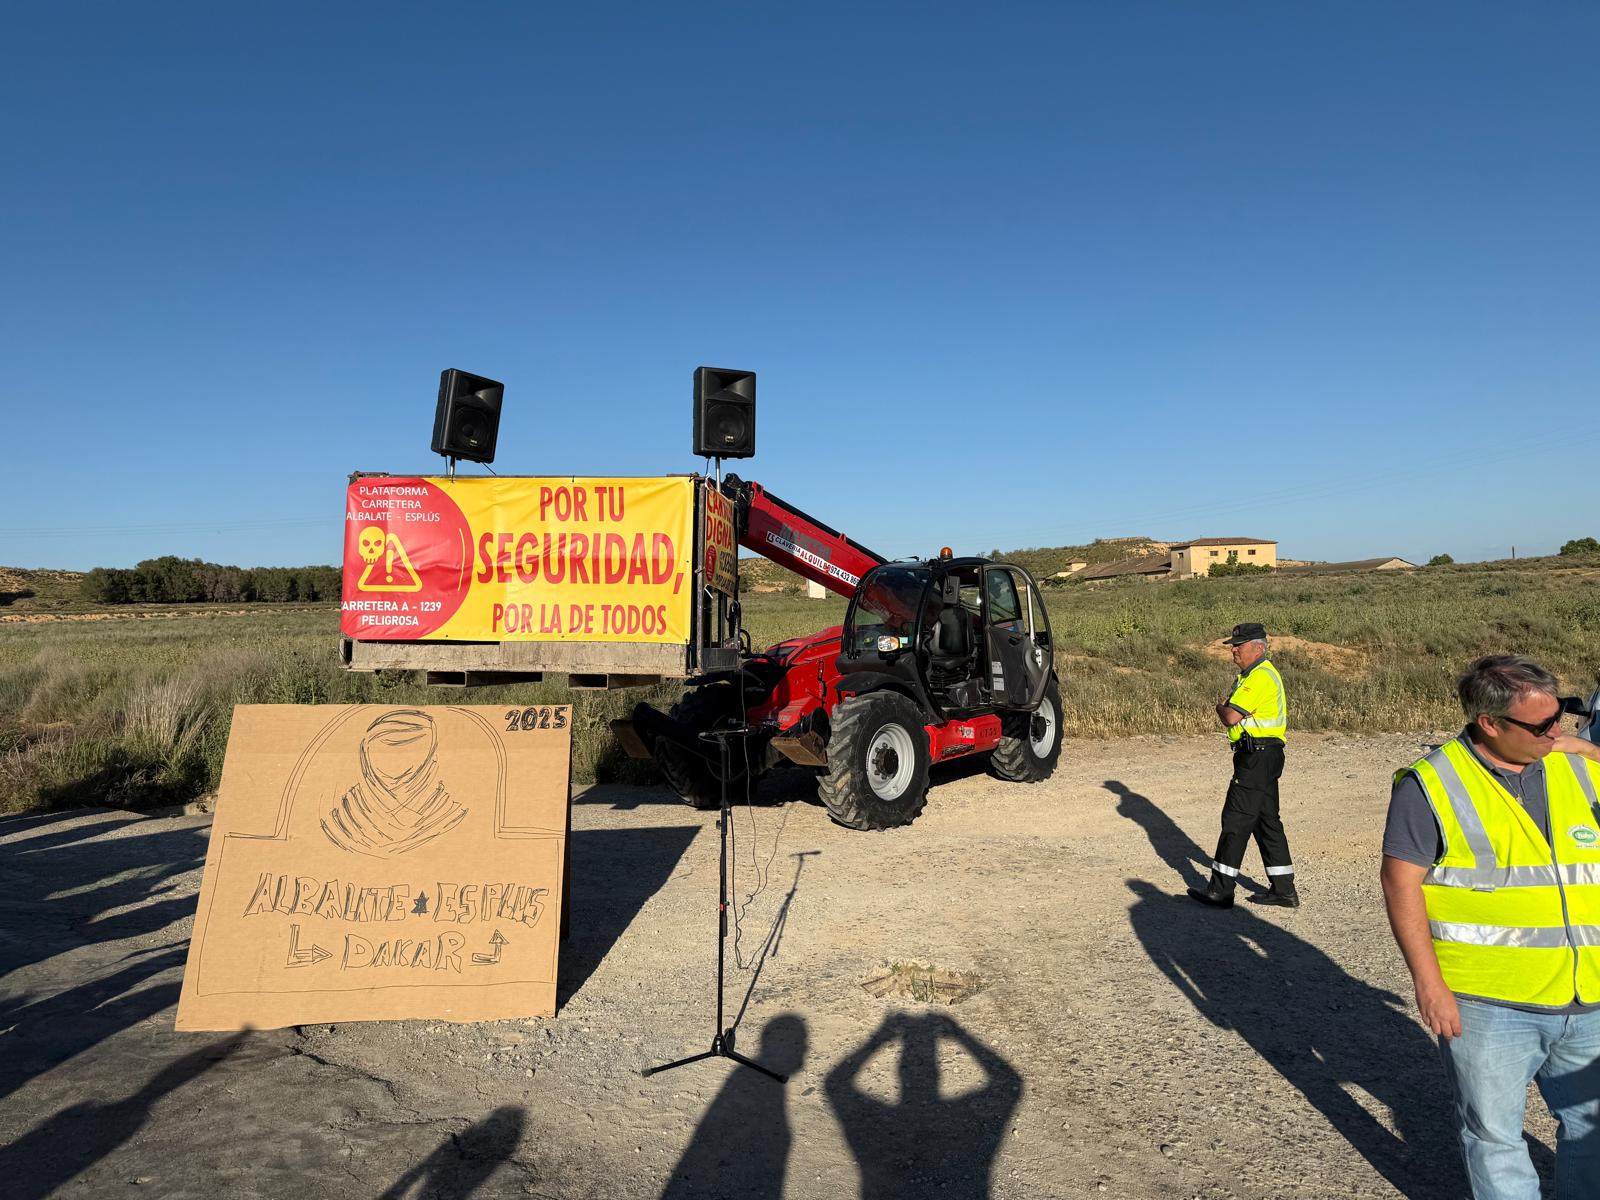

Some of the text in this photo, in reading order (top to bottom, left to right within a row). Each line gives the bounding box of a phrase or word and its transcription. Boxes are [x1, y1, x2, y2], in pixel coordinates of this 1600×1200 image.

[359, 486, 429, 496] PLATAFORMA
[361, 499, 422, 509] CARRETERA
[540, 485, 624, 522] POR TU
[345, 511, 392, 521] ALBALATE
[405, 511, 440, 522] ESPLÚS
[706, 514, 732, 551] DIGNA
[477, 532, 684, 595] SEGURIDAD,
[341, 601, 399, 611] ARRETERA
[401, 601, 409, 611] A
[420, 601, 442, 612] 1239
[361, 615, 420, 626] PELIGROSA
[492, 603, 667, 635] POR LA DE TODOS
[505, 705, 568, 732] 2025
[433, 882, 550, 929] ESPLUS
[340, 931, 467, 974] DAKAR
